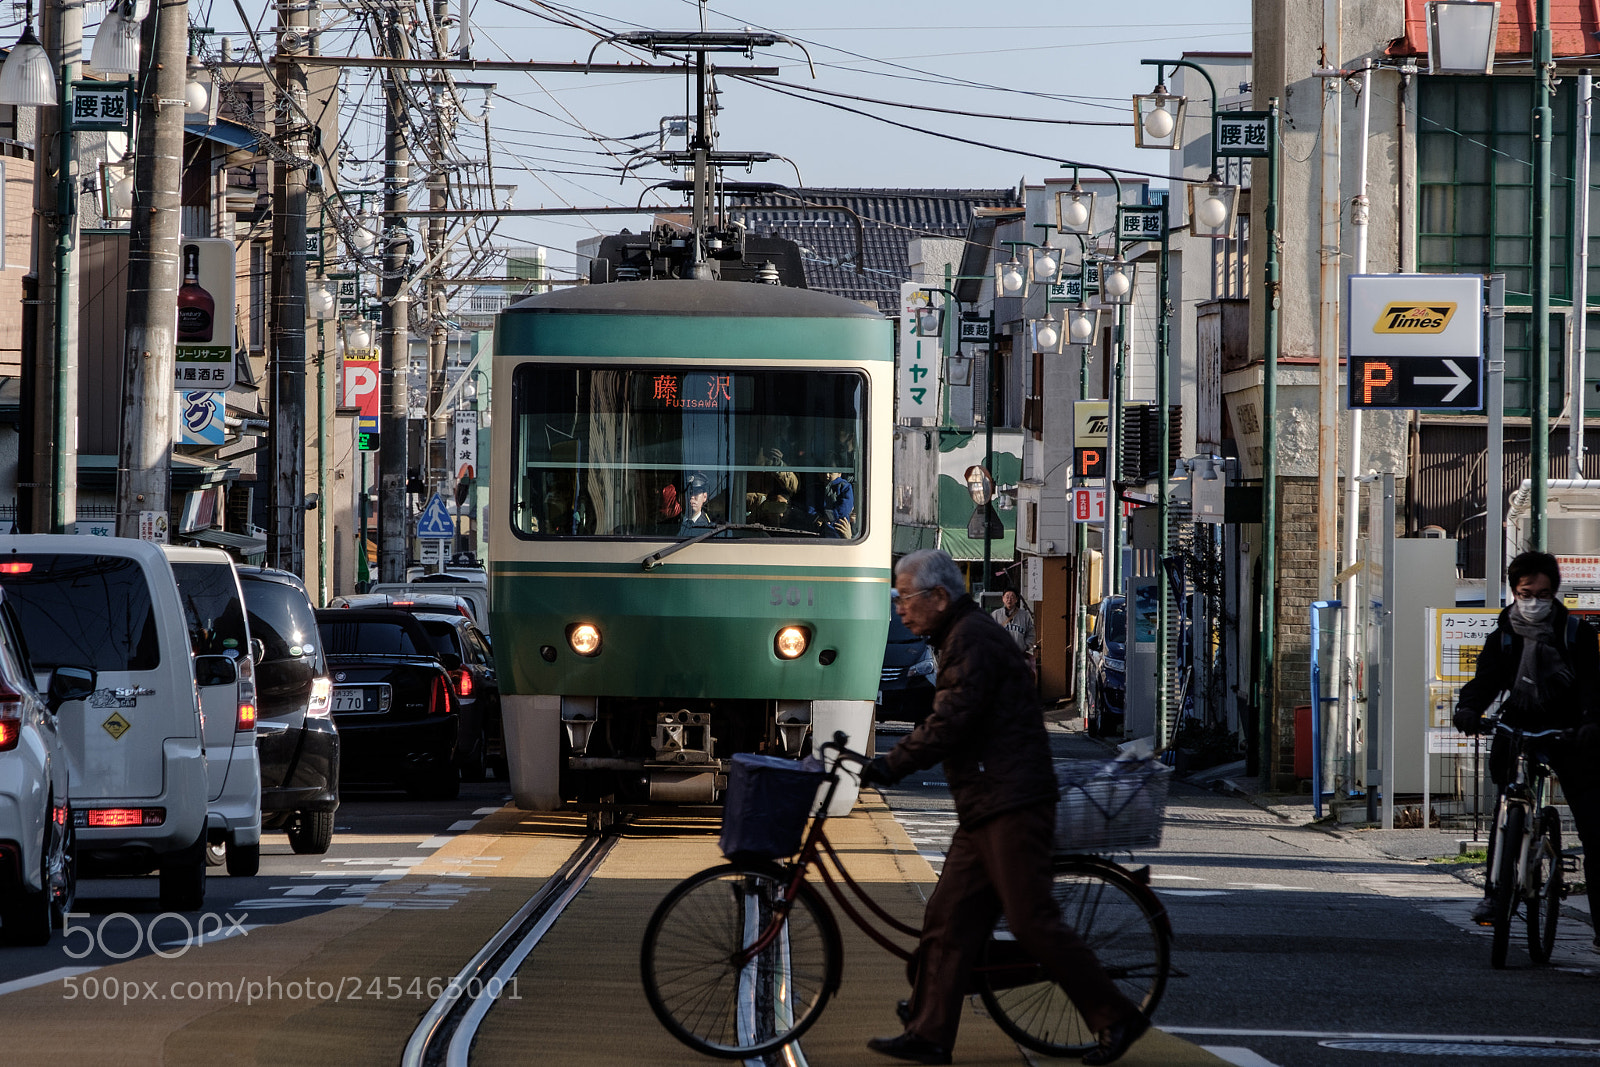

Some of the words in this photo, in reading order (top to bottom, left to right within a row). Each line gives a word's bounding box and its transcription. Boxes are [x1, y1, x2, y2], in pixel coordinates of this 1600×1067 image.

[75, 95, 125, 118] 腰越
[1220, 124, 1267, 145] 腰越
[1123, 215, 1159, 232] 腰越
[341, 282, 354, 295] 越
[1051, 282, 1080, 295] 腰越
[1386, 307, 1446, 329] Times
[963, 324, 988, 336] 腰越
[176, 349, 227, 359] リーリザーブ
[345, 366, 377, 407] P
[653, 375, 731, 401] 藤沢
[1363, 362, 1393, 403] P
[665, 400, 719, 408] FUJISAWA
[1082, 450, 1100, 475] P
[770, 586, 813, 606] 501
